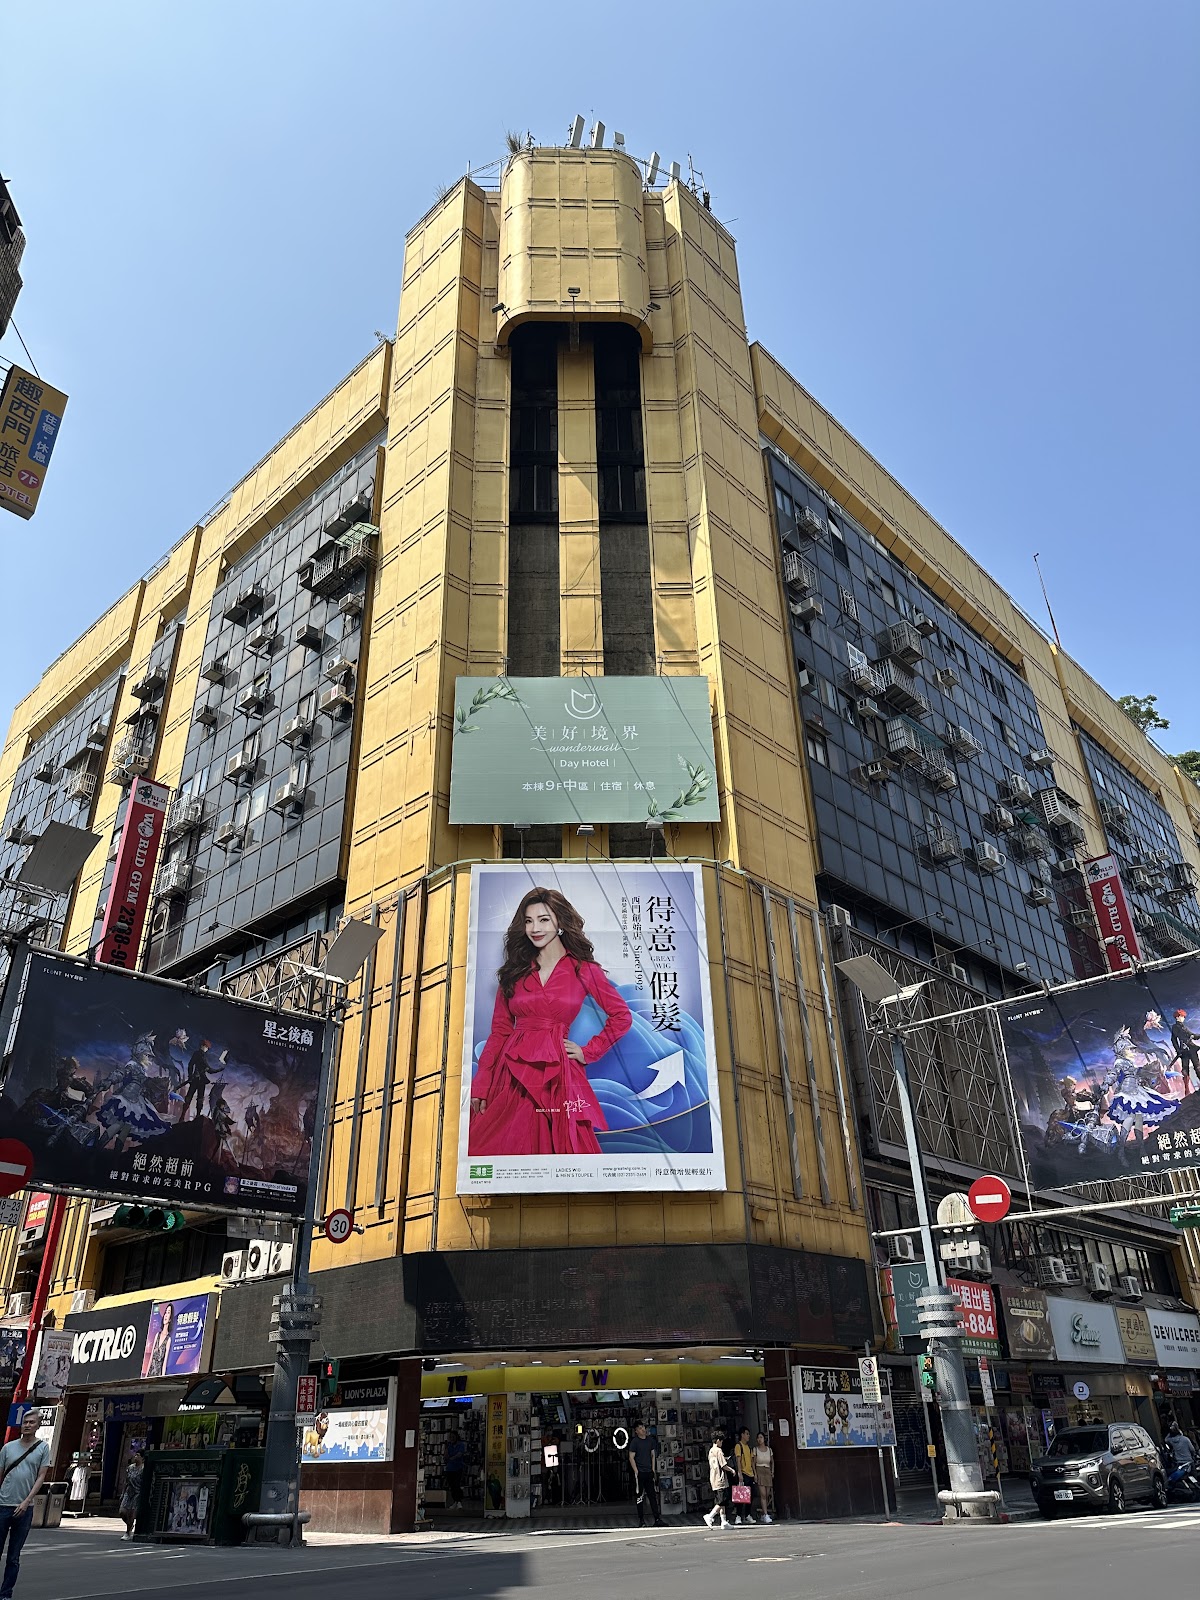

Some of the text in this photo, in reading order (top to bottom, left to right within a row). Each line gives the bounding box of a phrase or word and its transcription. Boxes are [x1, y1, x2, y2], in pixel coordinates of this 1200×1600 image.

[20, 471, 39, 485] 7F
[0, 481, 33, 507] OTEL
[549, 743, 620, 753] wonderwall
[560, 759, 609, 768] Day Hotel
[600, 781, 622, 791] 住宿
[126, 870, 142, 905] GYM
[331, 1219, 347, 1234] 30
[1153, 1324, 1200, 1343] DEVILCASE
[802, 1370, 839, 1392] 獅子林
[344, 1386, 387, 1400] LION'S PLAZA
